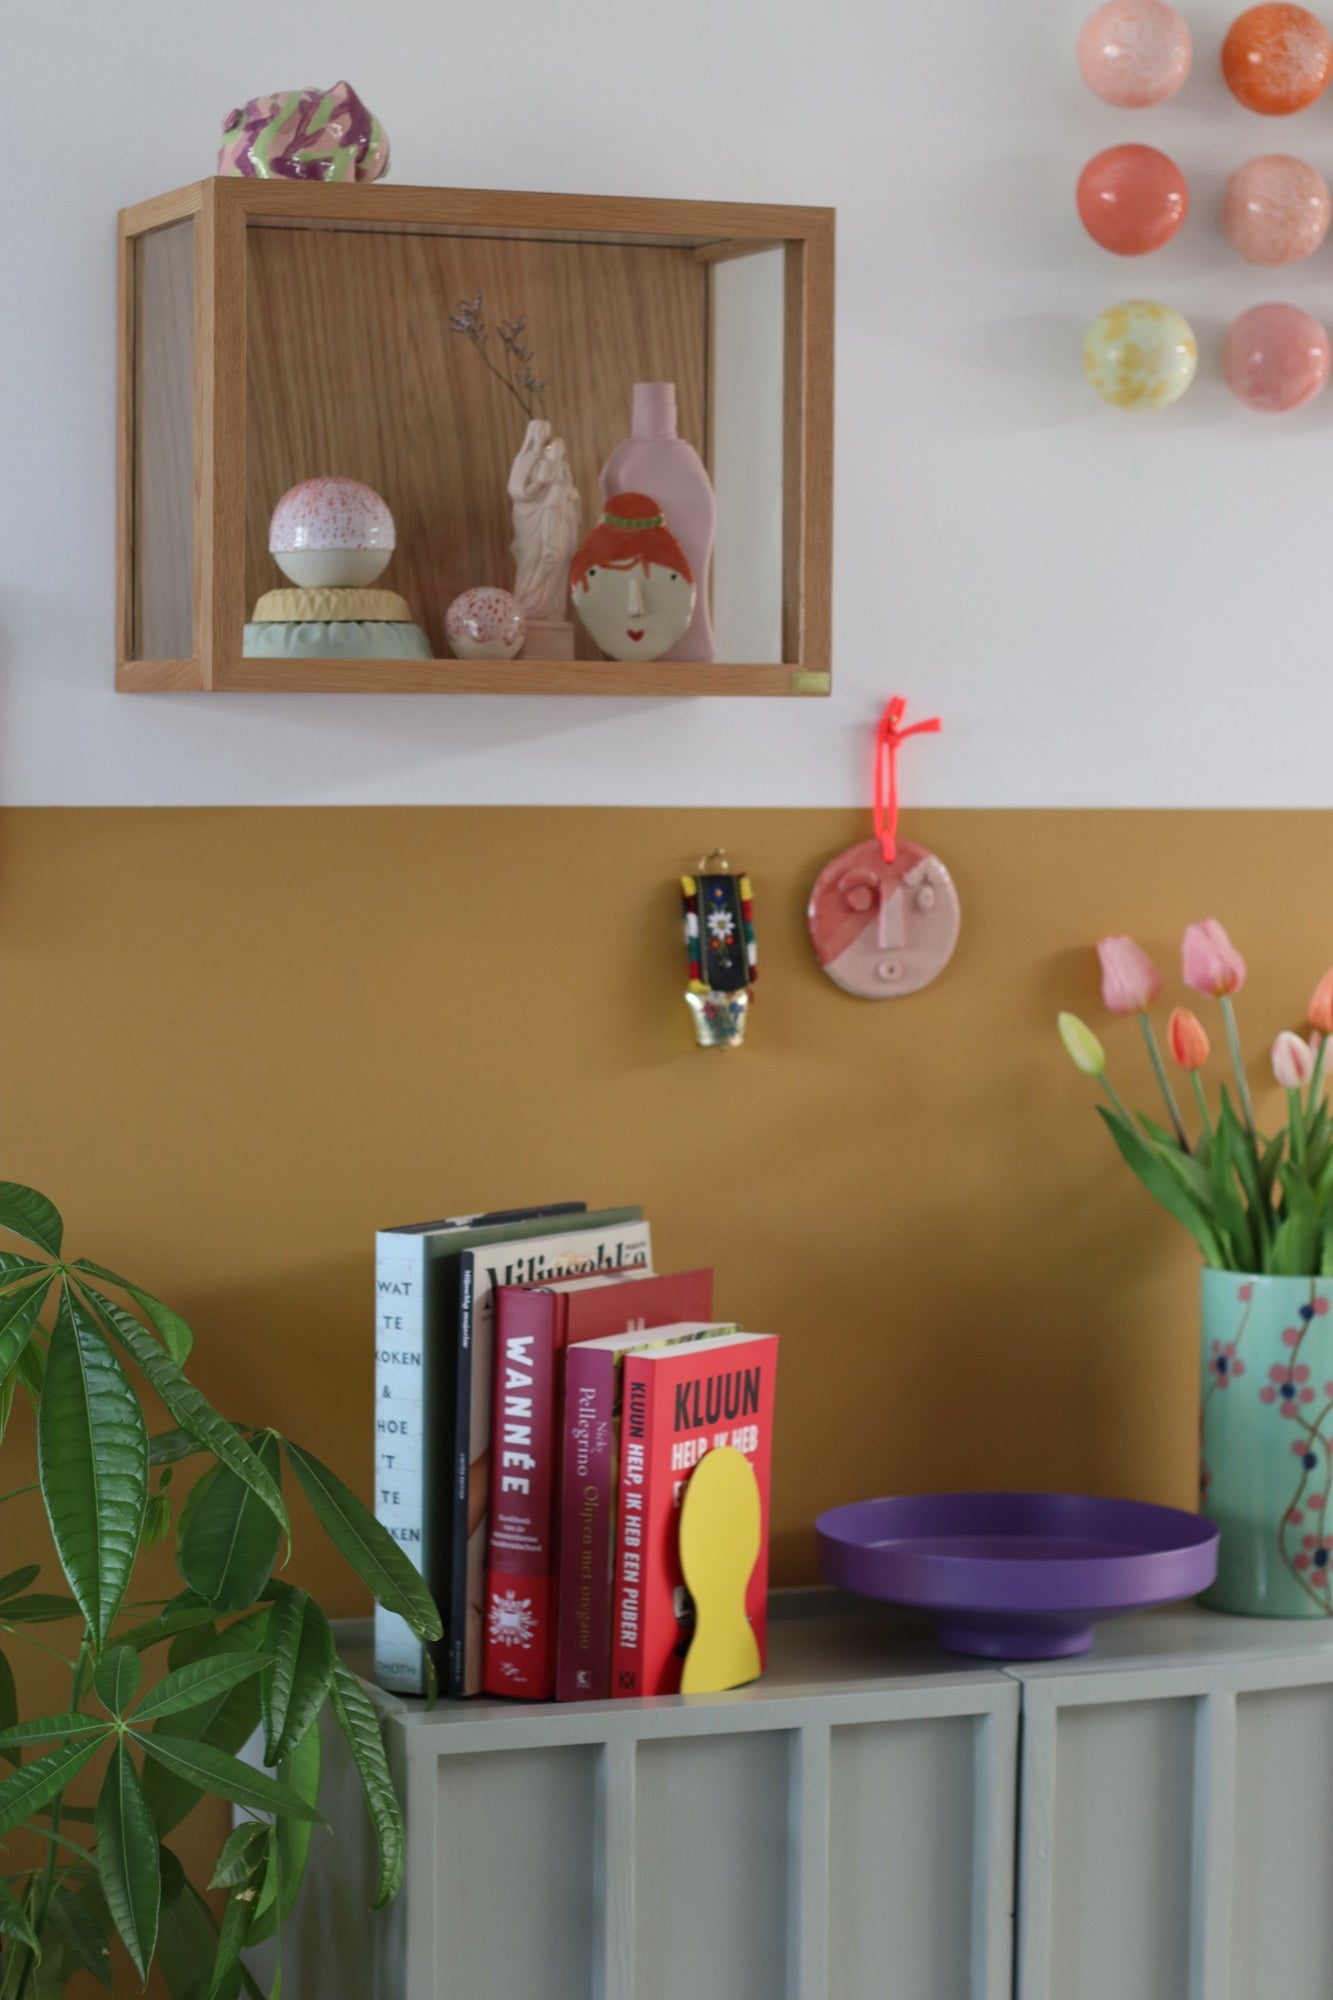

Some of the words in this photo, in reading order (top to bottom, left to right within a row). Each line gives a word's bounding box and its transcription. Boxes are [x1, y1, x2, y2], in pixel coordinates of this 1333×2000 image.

[378, 1281, 413, 1296] WAT
[383, 1315, 403, 1330] TE
[382, 1385, 392, 1398] &
[674, 1366, 761, 1432] KLUUN
[502, 1335, 537, 1495] WANNÉE
[630, 1382, 646, 1438] KLUUN
[378, 1420, 408, 1435] HOE
[573, 1387, 597, 1477] Pellegrino
[593, 1420, 608, 1455] Nicky
[731, 1424, 759, 1455] HEB
[623, 1443, 644, 1486] HELP,
[381, 1489, 401, 1505] TE
[625, 1492, 642, 1511] IK
[578, 1485, 600, 1544] Olijven
[388, 1527, 420, 1542] KEN
[624, 1515, 641, 1547] HEB
[580, 1550, 593, 1580] met
[622, 1552, 640, 1583] EEN
[574, 1585, 592, 1650] oregano
[619, 1587, 639, 1649] PUBER!
